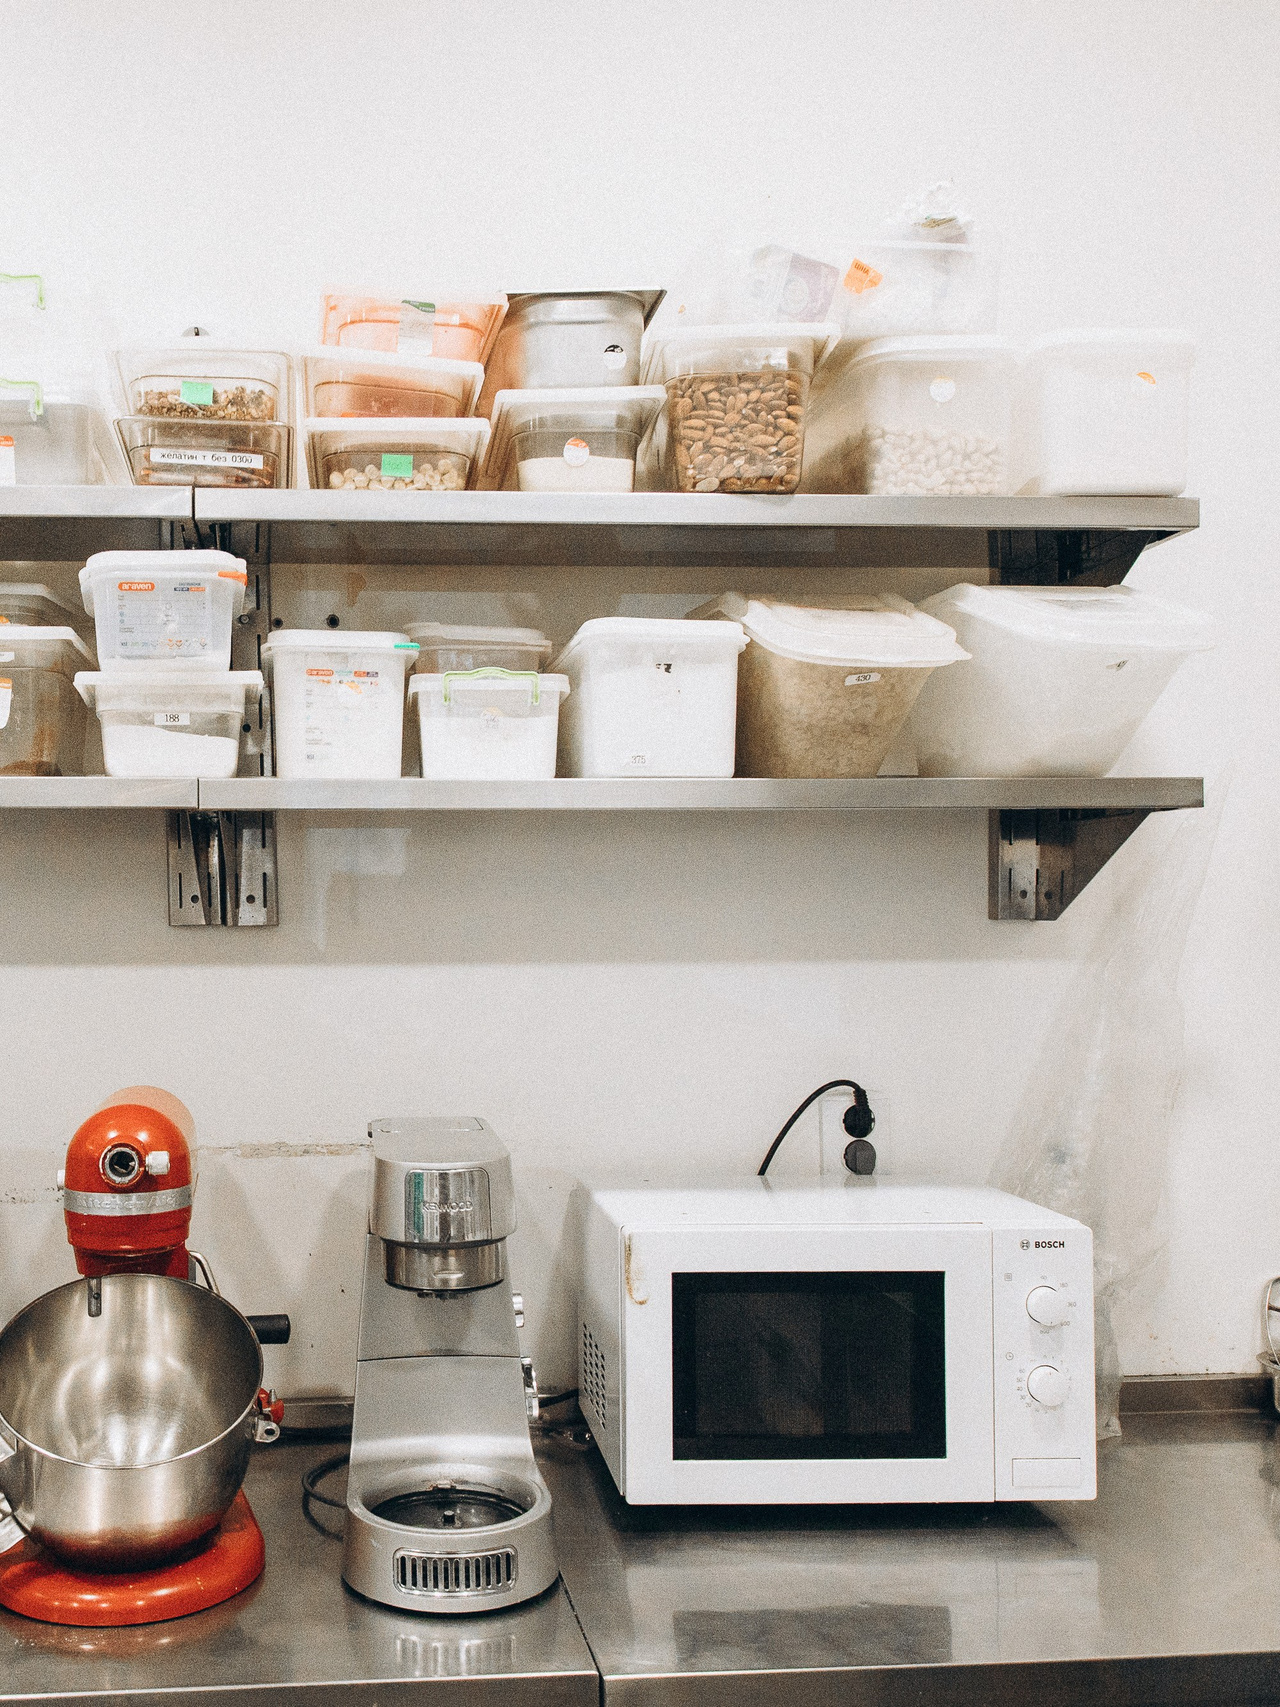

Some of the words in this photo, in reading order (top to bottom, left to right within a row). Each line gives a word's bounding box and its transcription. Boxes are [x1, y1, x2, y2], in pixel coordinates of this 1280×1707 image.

[160, 451, 198, 461] желатин
[211, 454, 227, 463] без
[121, 582, 152, 590] araven
[855, 674, 872, 682] 430
[165, 713, 180, 722] 188
[631, 755, 646, 764] 375
[422, 1200, 474, 1212] KENWOOD
[1034, 1240, 1065, 1249] BOSCH
